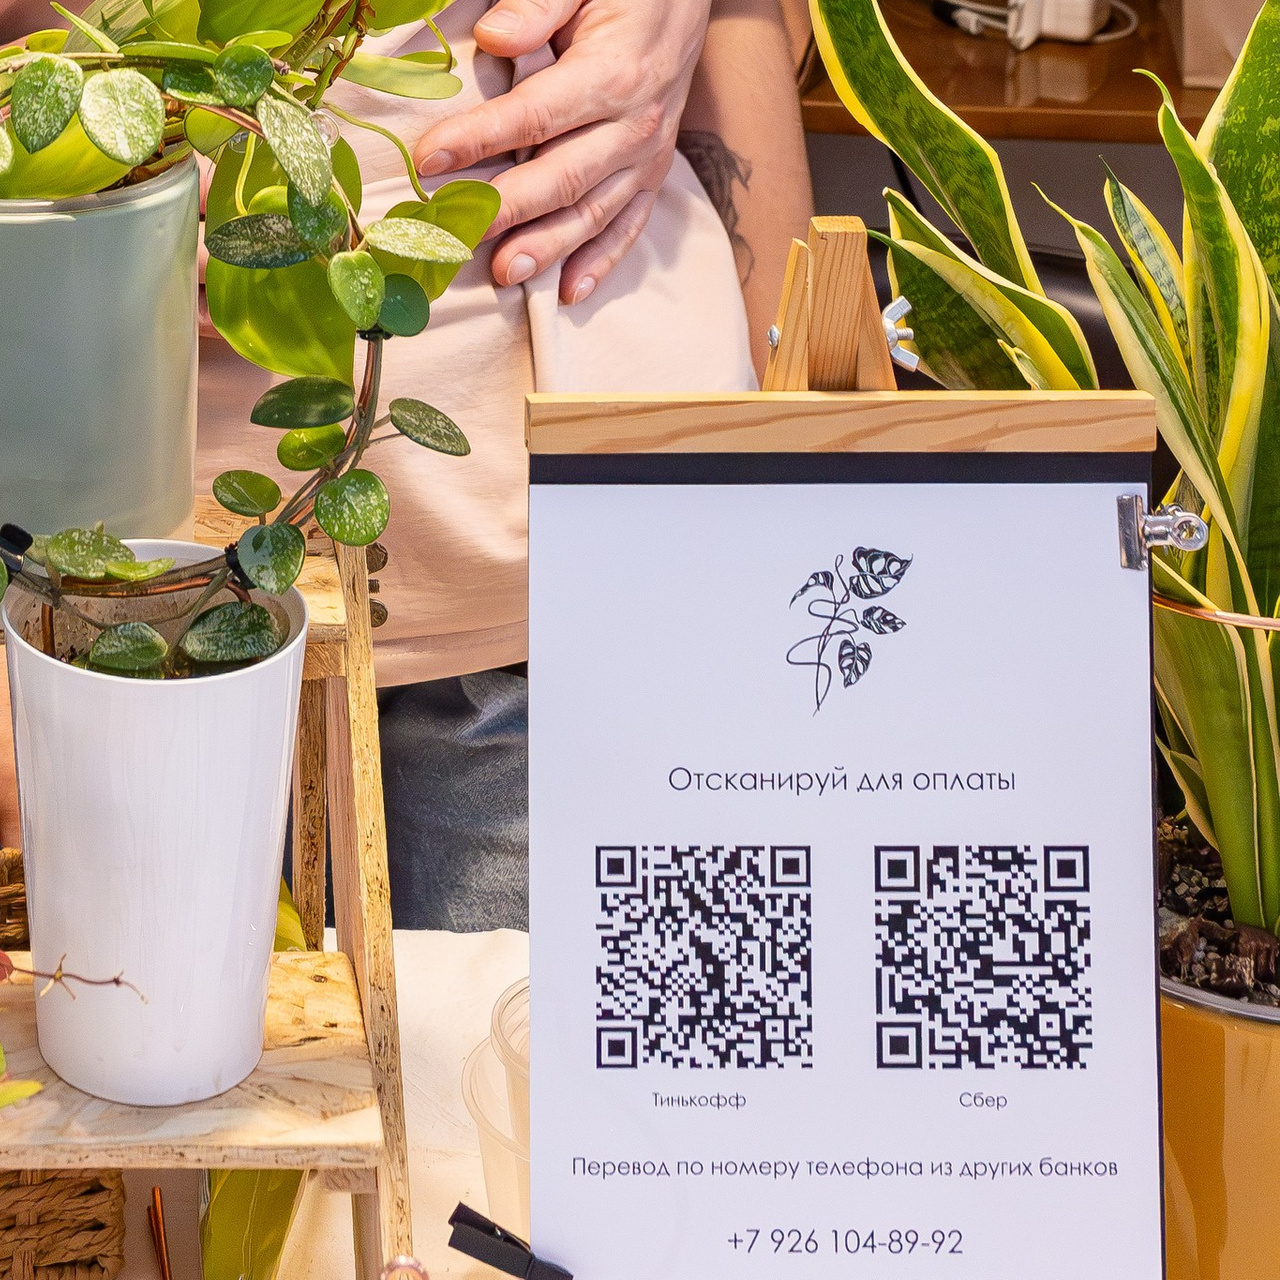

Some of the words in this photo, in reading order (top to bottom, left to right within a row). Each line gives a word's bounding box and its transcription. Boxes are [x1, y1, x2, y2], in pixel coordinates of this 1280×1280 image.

[668, 766, 847, 797] Отсканируй
[856, 772, 903, 793] для
[913, 771, 1016, 791] оплаты
[652, 1090, 747, 1111] Тинькофф
[958, 1090, 1008, 1112] Сбер
[572, 1156, 671, 1181] Перевод
[677, 1159, 704, 1177] по
[711, 1160, 800, 1181] номеру
[806, 1156, 923, 1180] телефона
[930, 1160, 953, 1177] из
[958, 1160, 1034, 1181] других
[1039, 1156, 1118, 1178] банков
[727, 1228, 761, 1254] +7
[770, 1228, 819, 1254] 926
[831, 1228, 964, 1255] 104-89-92
